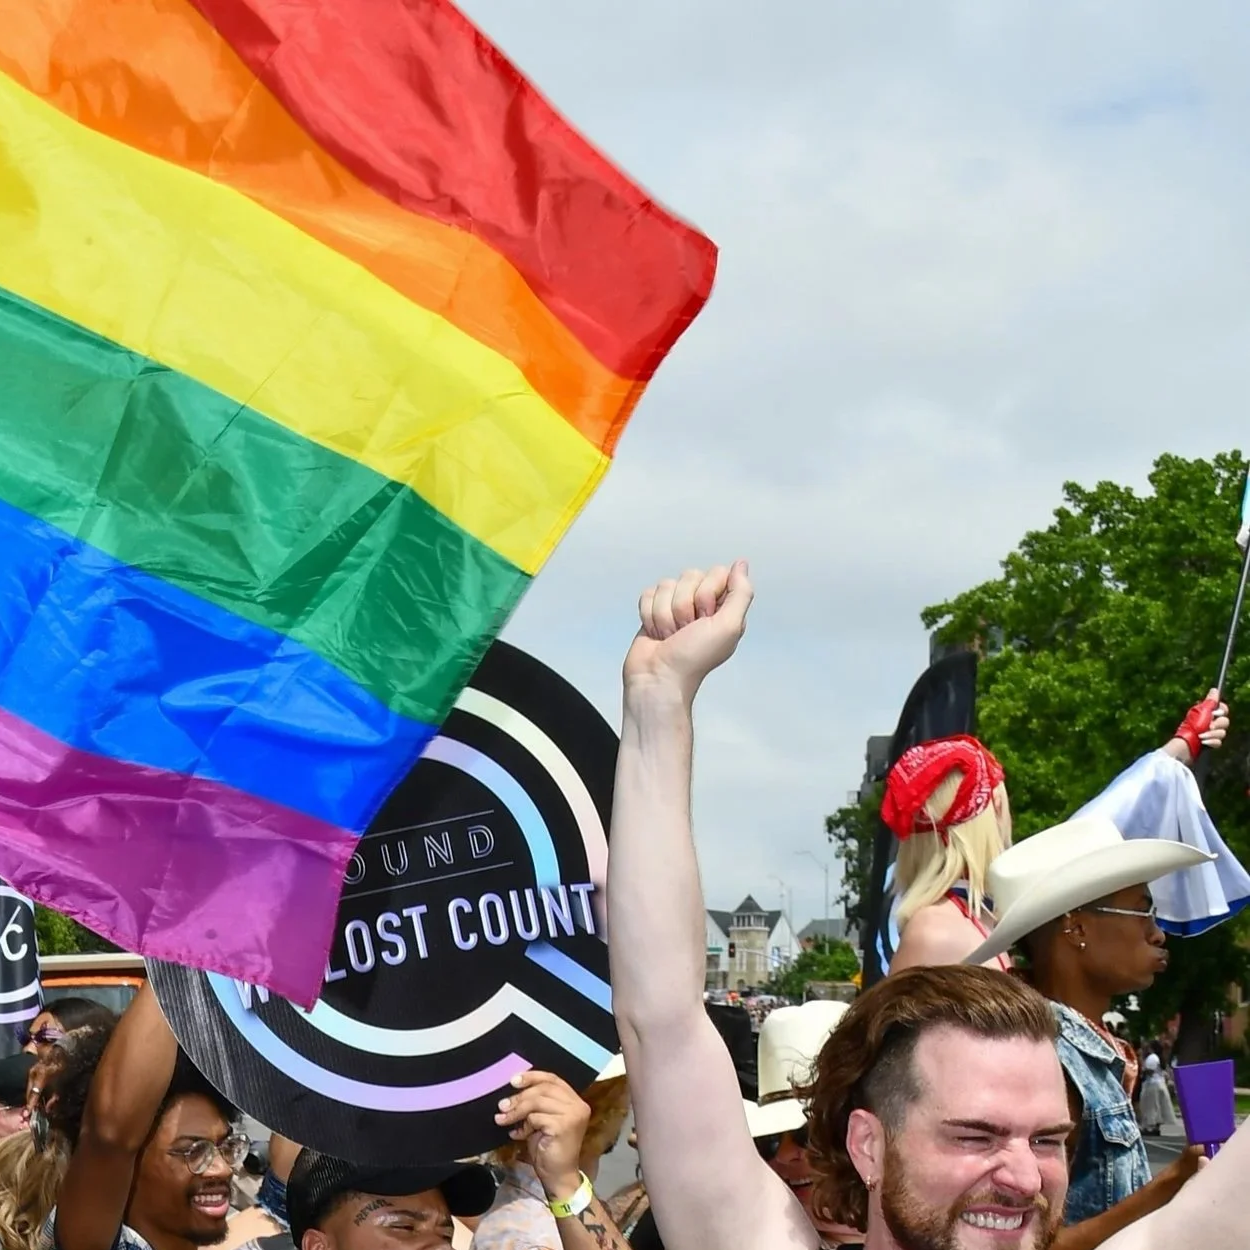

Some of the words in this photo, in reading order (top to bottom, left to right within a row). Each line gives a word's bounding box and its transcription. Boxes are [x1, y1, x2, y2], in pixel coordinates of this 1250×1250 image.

[342, 825, 495, 885] OUND
[325, 904, 429, 983] LOST
[447, 882, 596, 952] COUNT
